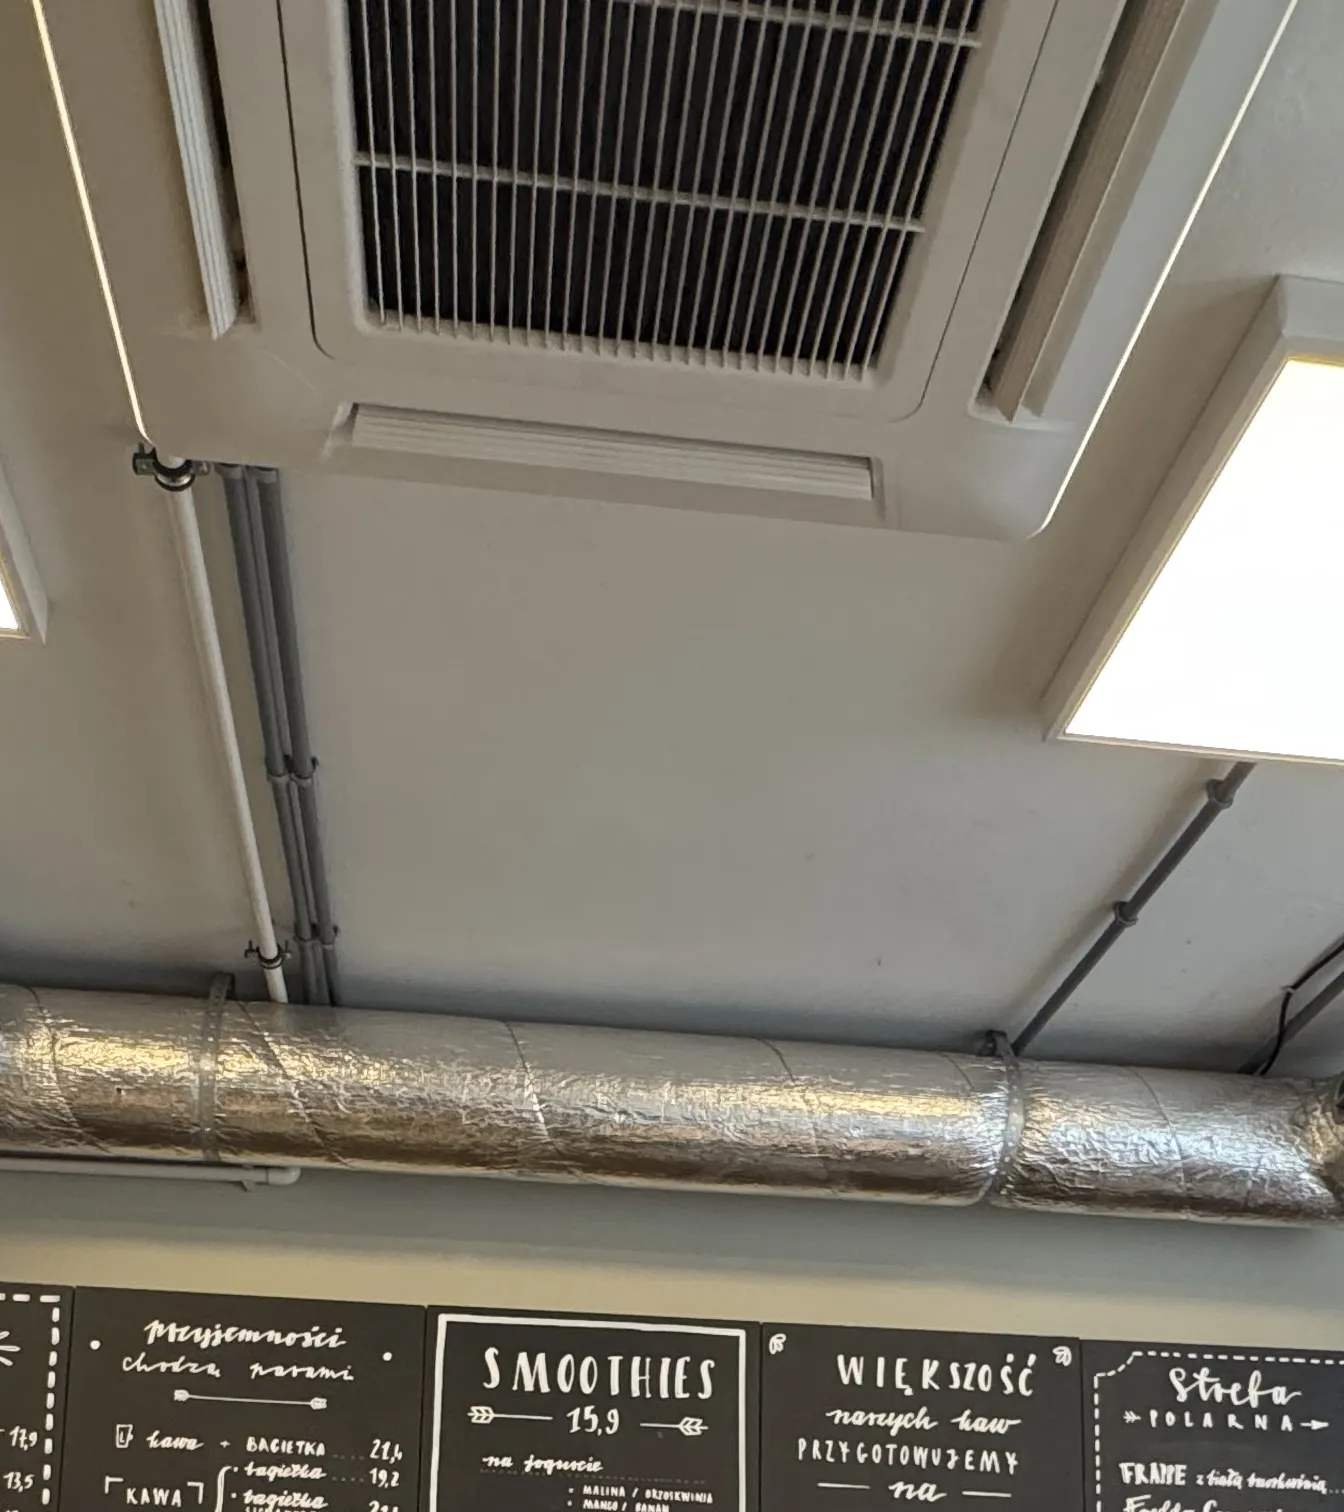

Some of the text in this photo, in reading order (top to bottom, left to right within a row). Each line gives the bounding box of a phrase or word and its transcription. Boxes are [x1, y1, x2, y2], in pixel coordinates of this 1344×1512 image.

[122, 1351, 354, 1381] chodzą parami
[482, 1346, 716, 1400] SMOOTHIES
[836, 1353, 1037, 1397] WIĘKSZOŚĆ
[1168, 1366, 1302, 1409] Strefa
[566, 1404, 620, 1436] 15,9
[825, 1406, 1022, 1437] naszych kaw
[1149, 1409, 1293, 1432] POLARNA
[9, 1425, 38, 1451] 17,9
[145, 1429, 403, 1464] kawa BAGIETKA 21,4
[482, 1454, 604, 1475] na jogurcie
[798, 1437, 1019, 1475] PRZYGOTOWUJEMY
[2, 1471, 35, 1493] 13,5
[243, 1461, 400, 1489] bagietka 19,2
[126, 1488, 182, 1506] KAWA
[242, 1487, 329, 1509] bagietka
[582, 1484, 626, 1498] MALINA
[888, 1481, 947, 1503] na
